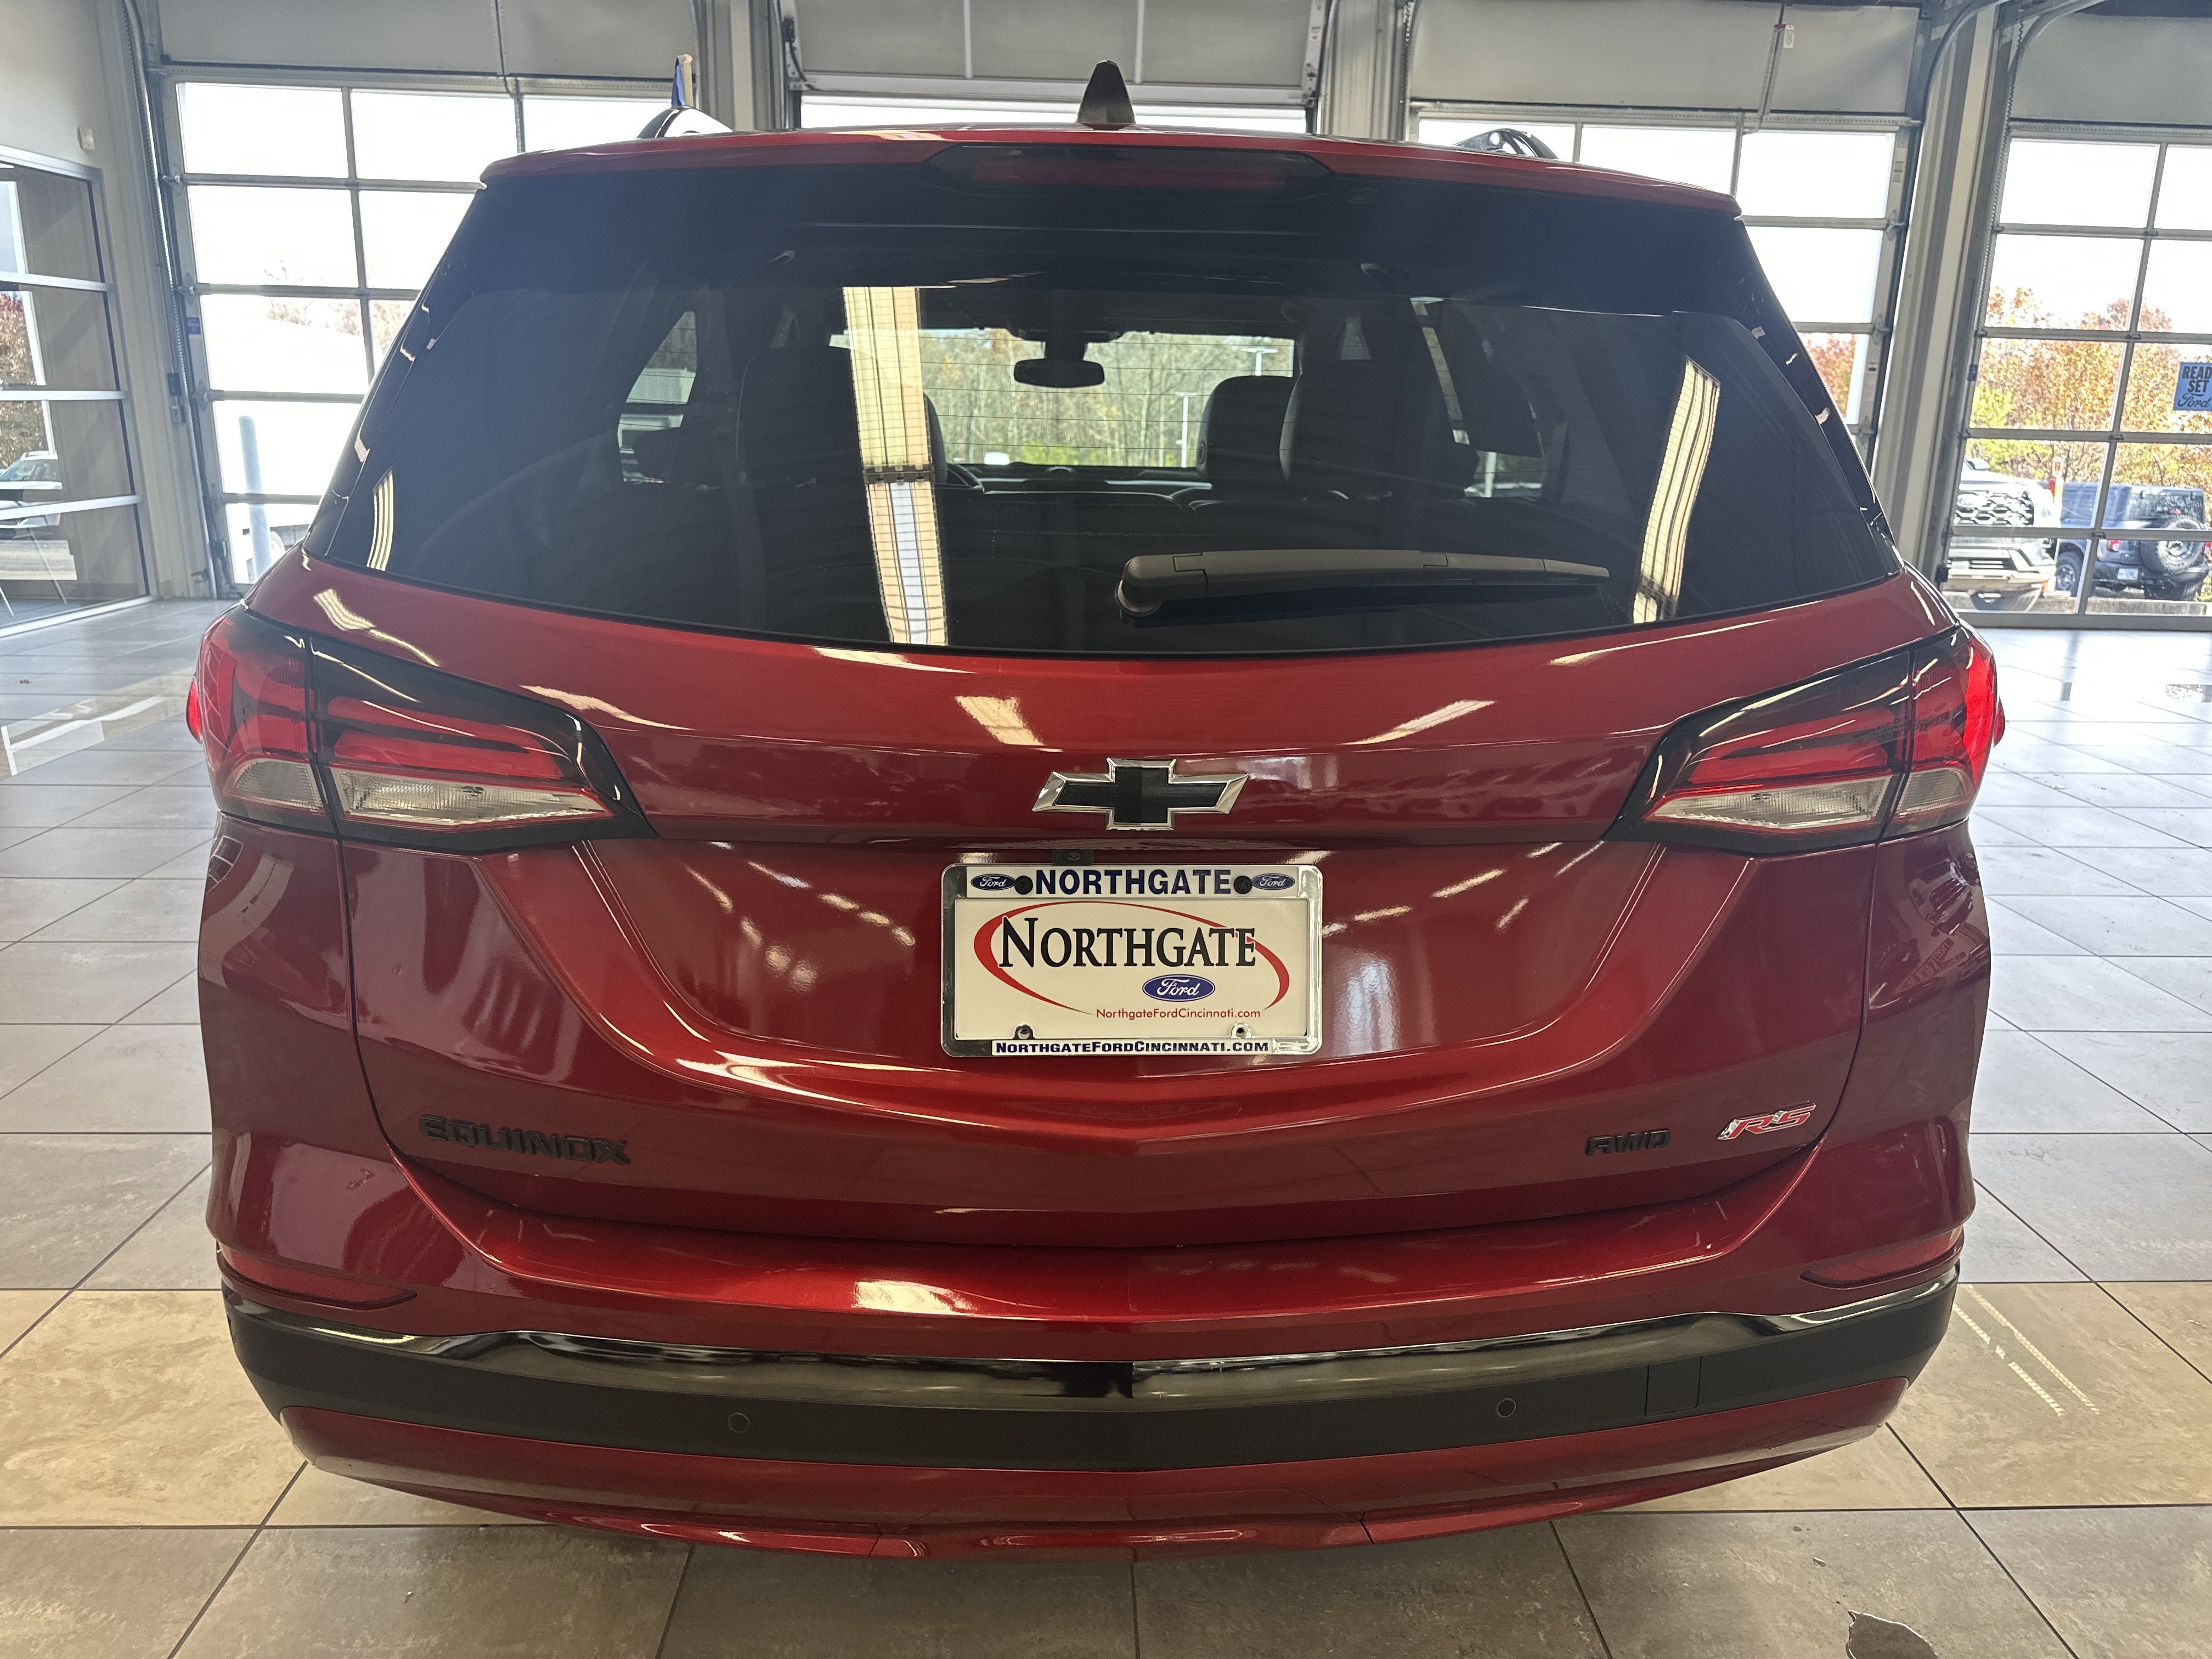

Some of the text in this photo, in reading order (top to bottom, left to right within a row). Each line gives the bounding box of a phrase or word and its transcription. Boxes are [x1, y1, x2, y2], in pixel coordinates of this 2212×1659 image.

[2187, 379, 2209, 393] SET
[2177, 392, 2212, 408] Ford
[979, 869, 1287, 895] Ford NORTHGATE Ford
[999, 917, 1256, 967] NORTHGATE
[1156, 978, 1200, 997] Ford
[1097, 1008, 1261, 1020] NorthgateFordCincinnati.com
[996, 1041, 1269, 1053] NORTHGATEFORDCINCINNATI.COM
[1717, 1102, 1816, 1141] RS
[419, 1114, 632, 1165] EQUINOX
[1585, 1128, 1671, 1156] AWD
